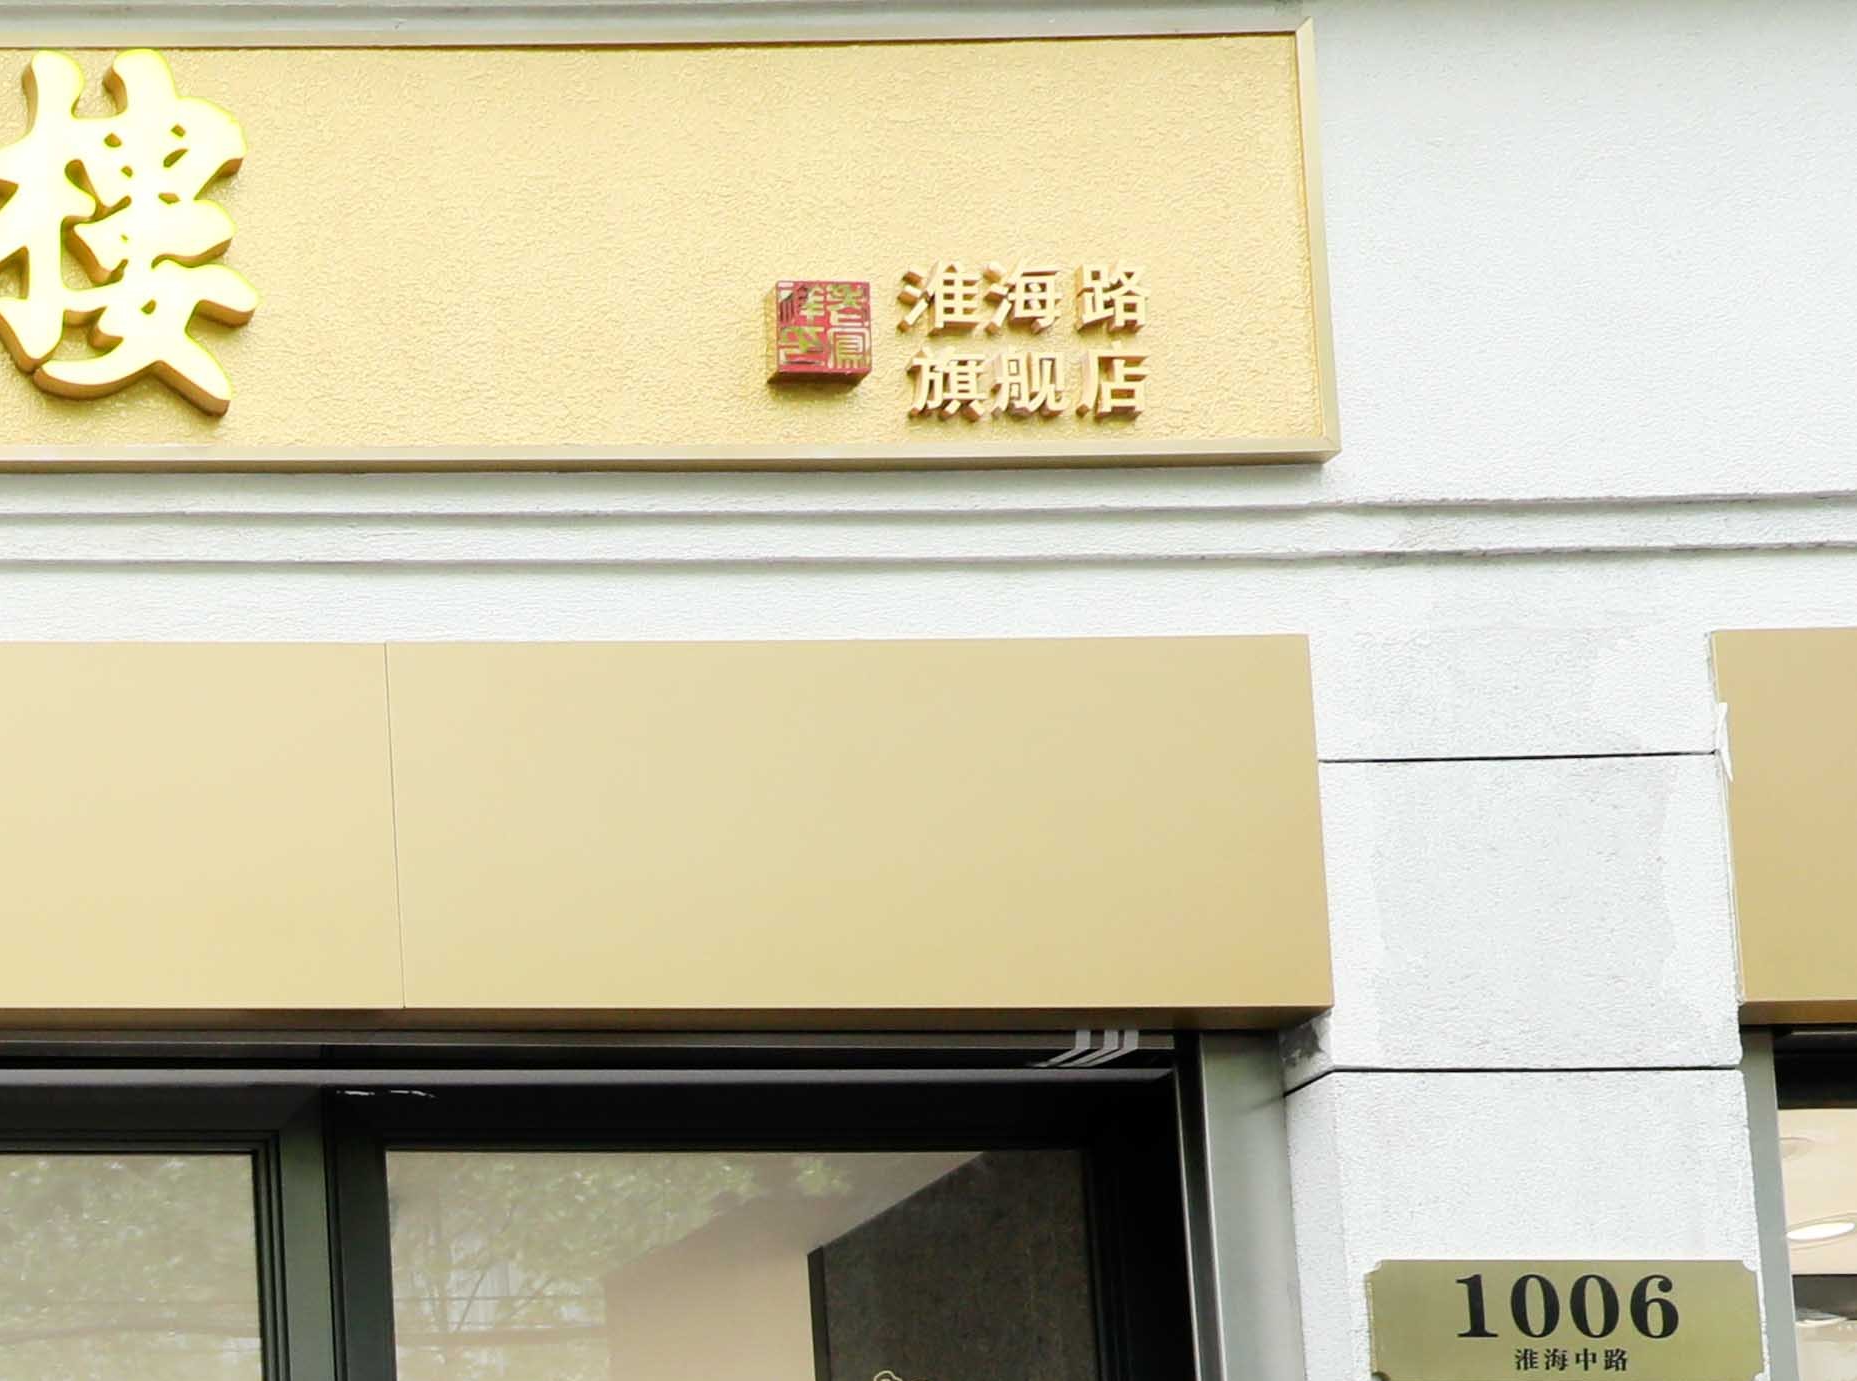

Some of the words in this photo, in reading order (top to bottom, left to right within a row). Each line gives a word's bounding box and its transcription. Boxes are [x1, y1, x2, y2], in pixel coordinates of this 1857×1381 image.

[898, 260, 1150, 334] 淮海路
[907, 340, 1152, 420] 旗舰店
[1455, 1273, 1680, 1339] 1006
[1515, 1348, 1630, 1372] 淮海中路
